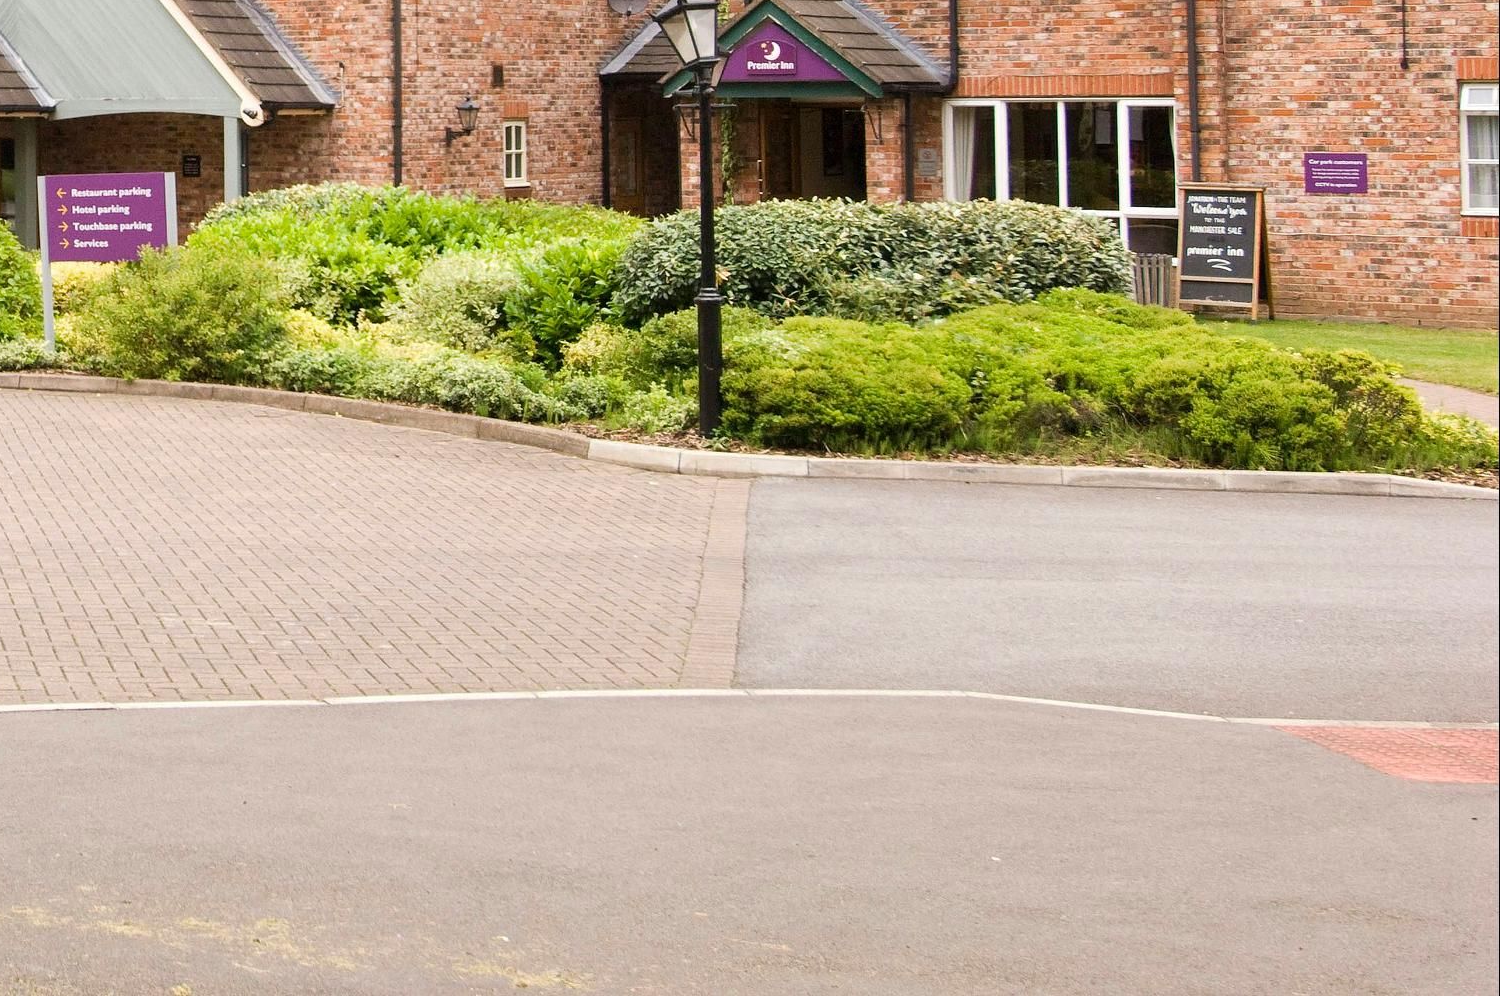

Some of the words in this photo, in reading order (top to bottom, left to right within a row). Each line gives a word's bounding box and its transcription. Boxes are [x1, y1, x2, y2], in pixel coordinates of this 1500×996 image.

[747, 61, 780, 70] Premier
[780, 61, 794, 70] Inn
[71, 188, 118, 198] Restaurant
[119, 186, 152, 198] parking
[72, 205, 96, 214] Hotel
[97, 204, 130, 215] parking
[73, 222, 118, 231] Touchbase
[119, 221, 153, 232] parking
[1227, 226, 1244, 235] SALE
[74, 239, 109, 248] Services
[1186, 245, 1224, 256] premier
[1227, 245, 1245, 257] inn
